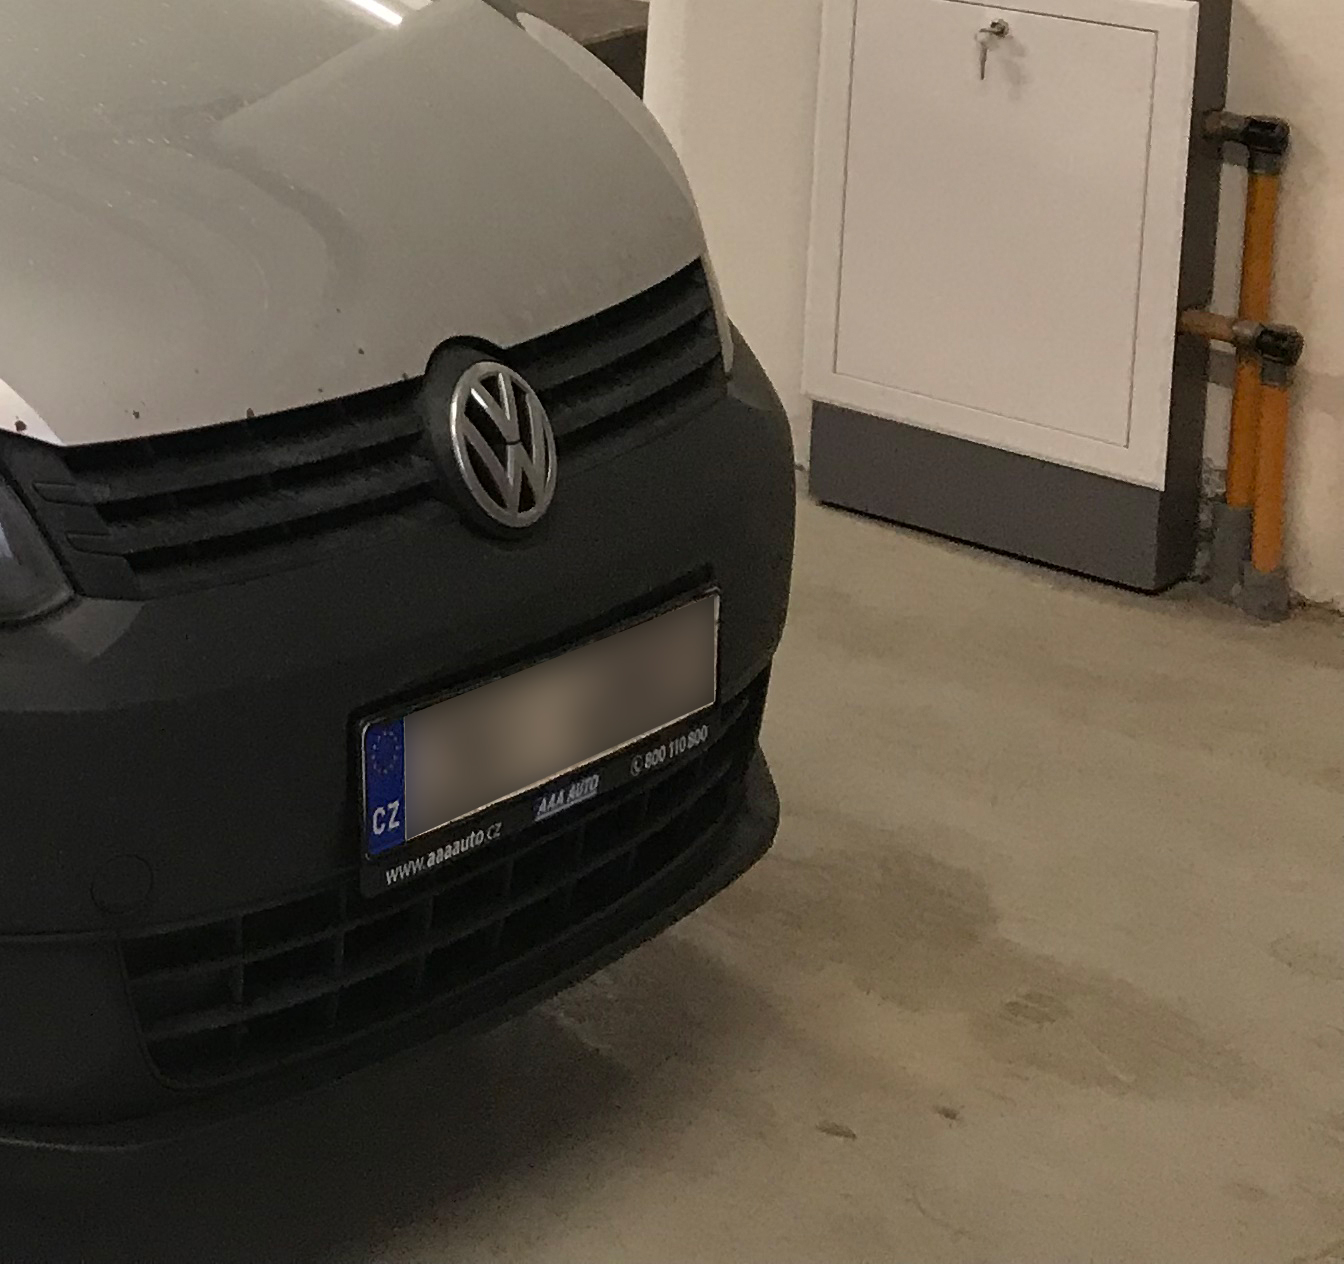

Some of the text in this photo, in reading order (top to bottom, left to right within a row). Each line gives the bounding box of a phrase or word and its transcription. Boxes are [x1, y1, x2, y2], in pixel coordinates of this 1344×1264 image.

[537, 774, 600, 816] AAA AUTO
[372, 800, 400, 836] CZ
[385, 821, 502, 886] www.aaaauto.cz
